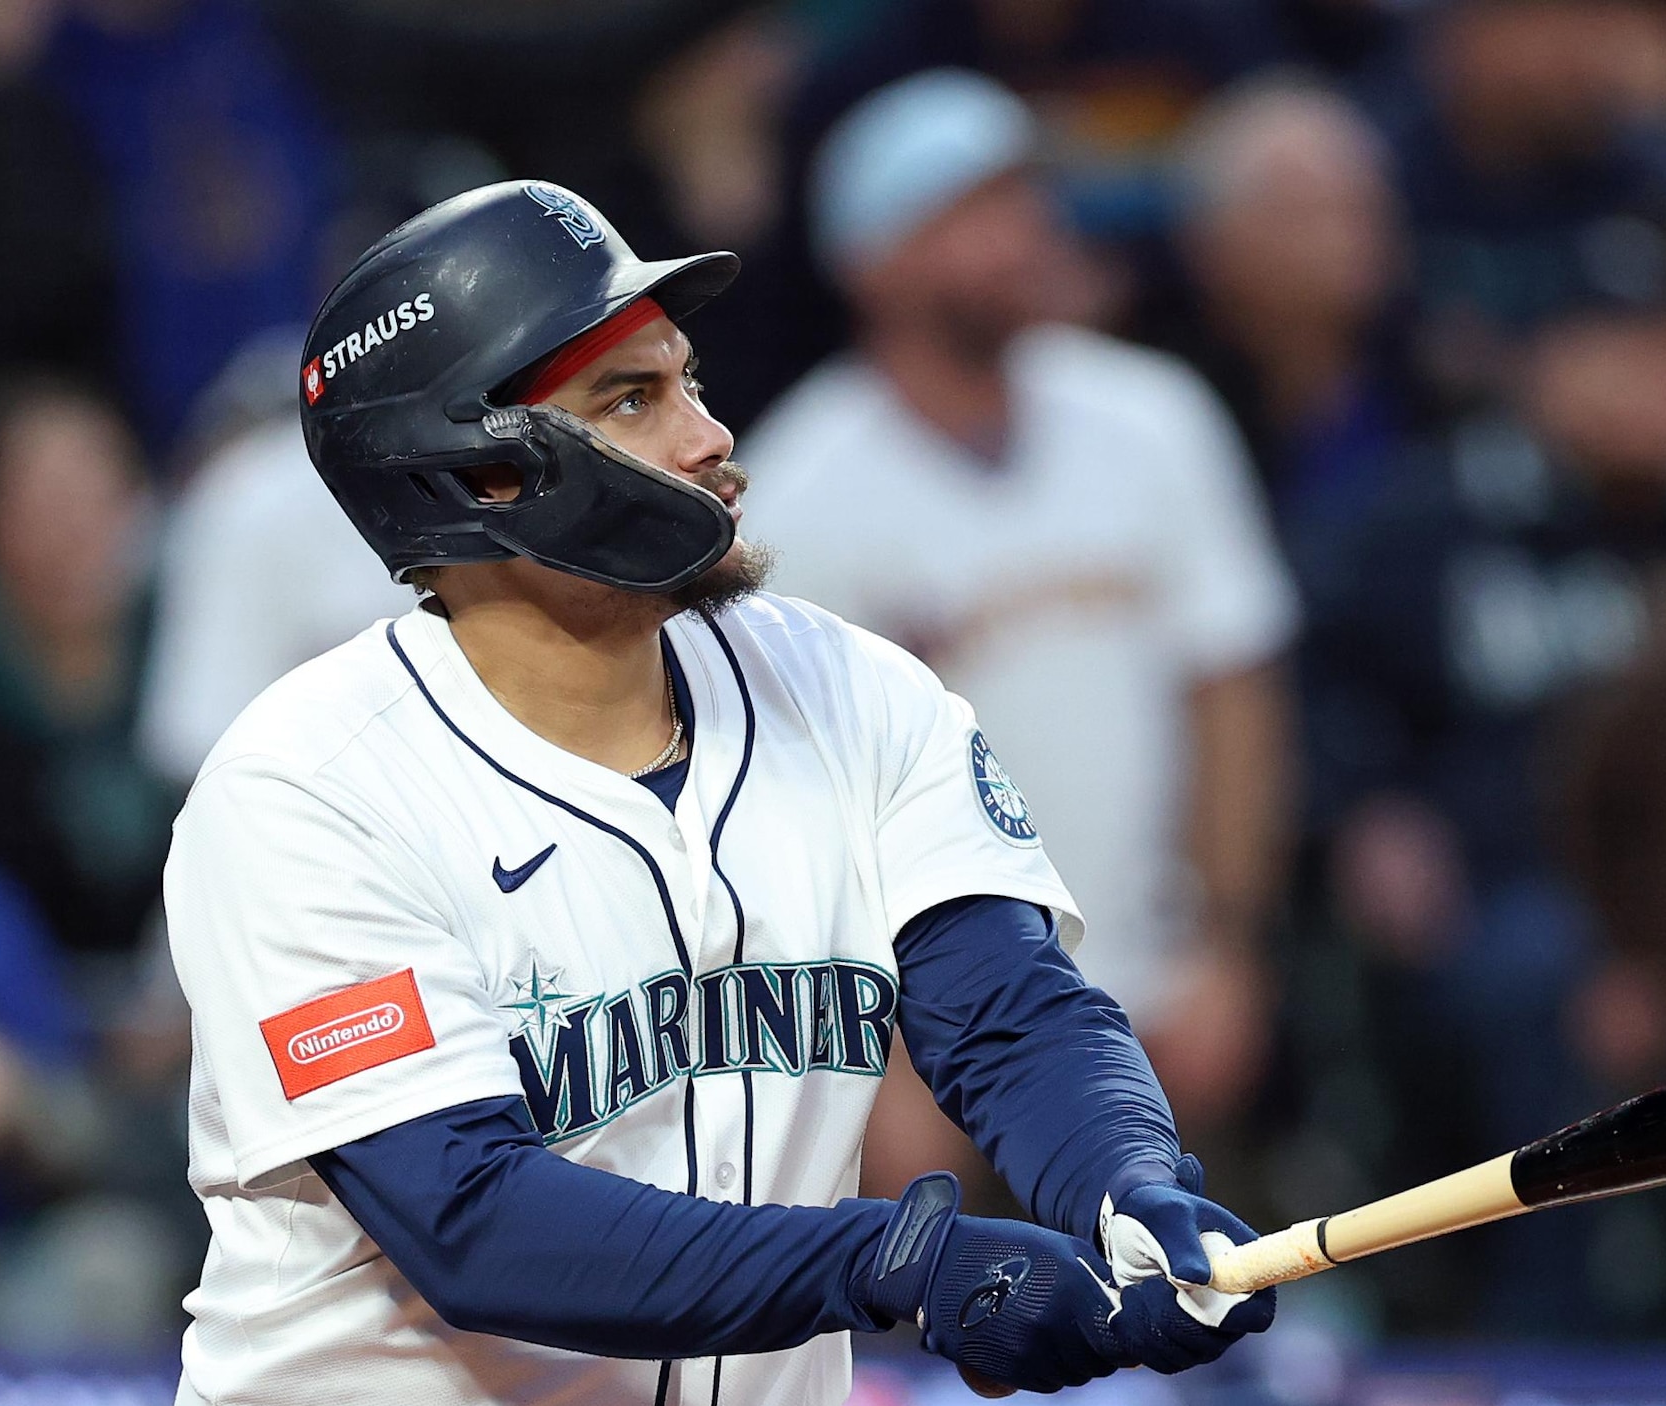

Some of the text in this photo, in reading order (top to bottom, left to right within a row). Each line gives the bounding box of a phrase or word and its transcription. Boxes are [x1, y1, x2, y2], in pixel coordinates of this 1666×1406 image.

[323, 293, 435, 379] STRAUSS
[297, 1013, 394, 1058] Nintendo
[506, 957, 901, 1146] MARINER
